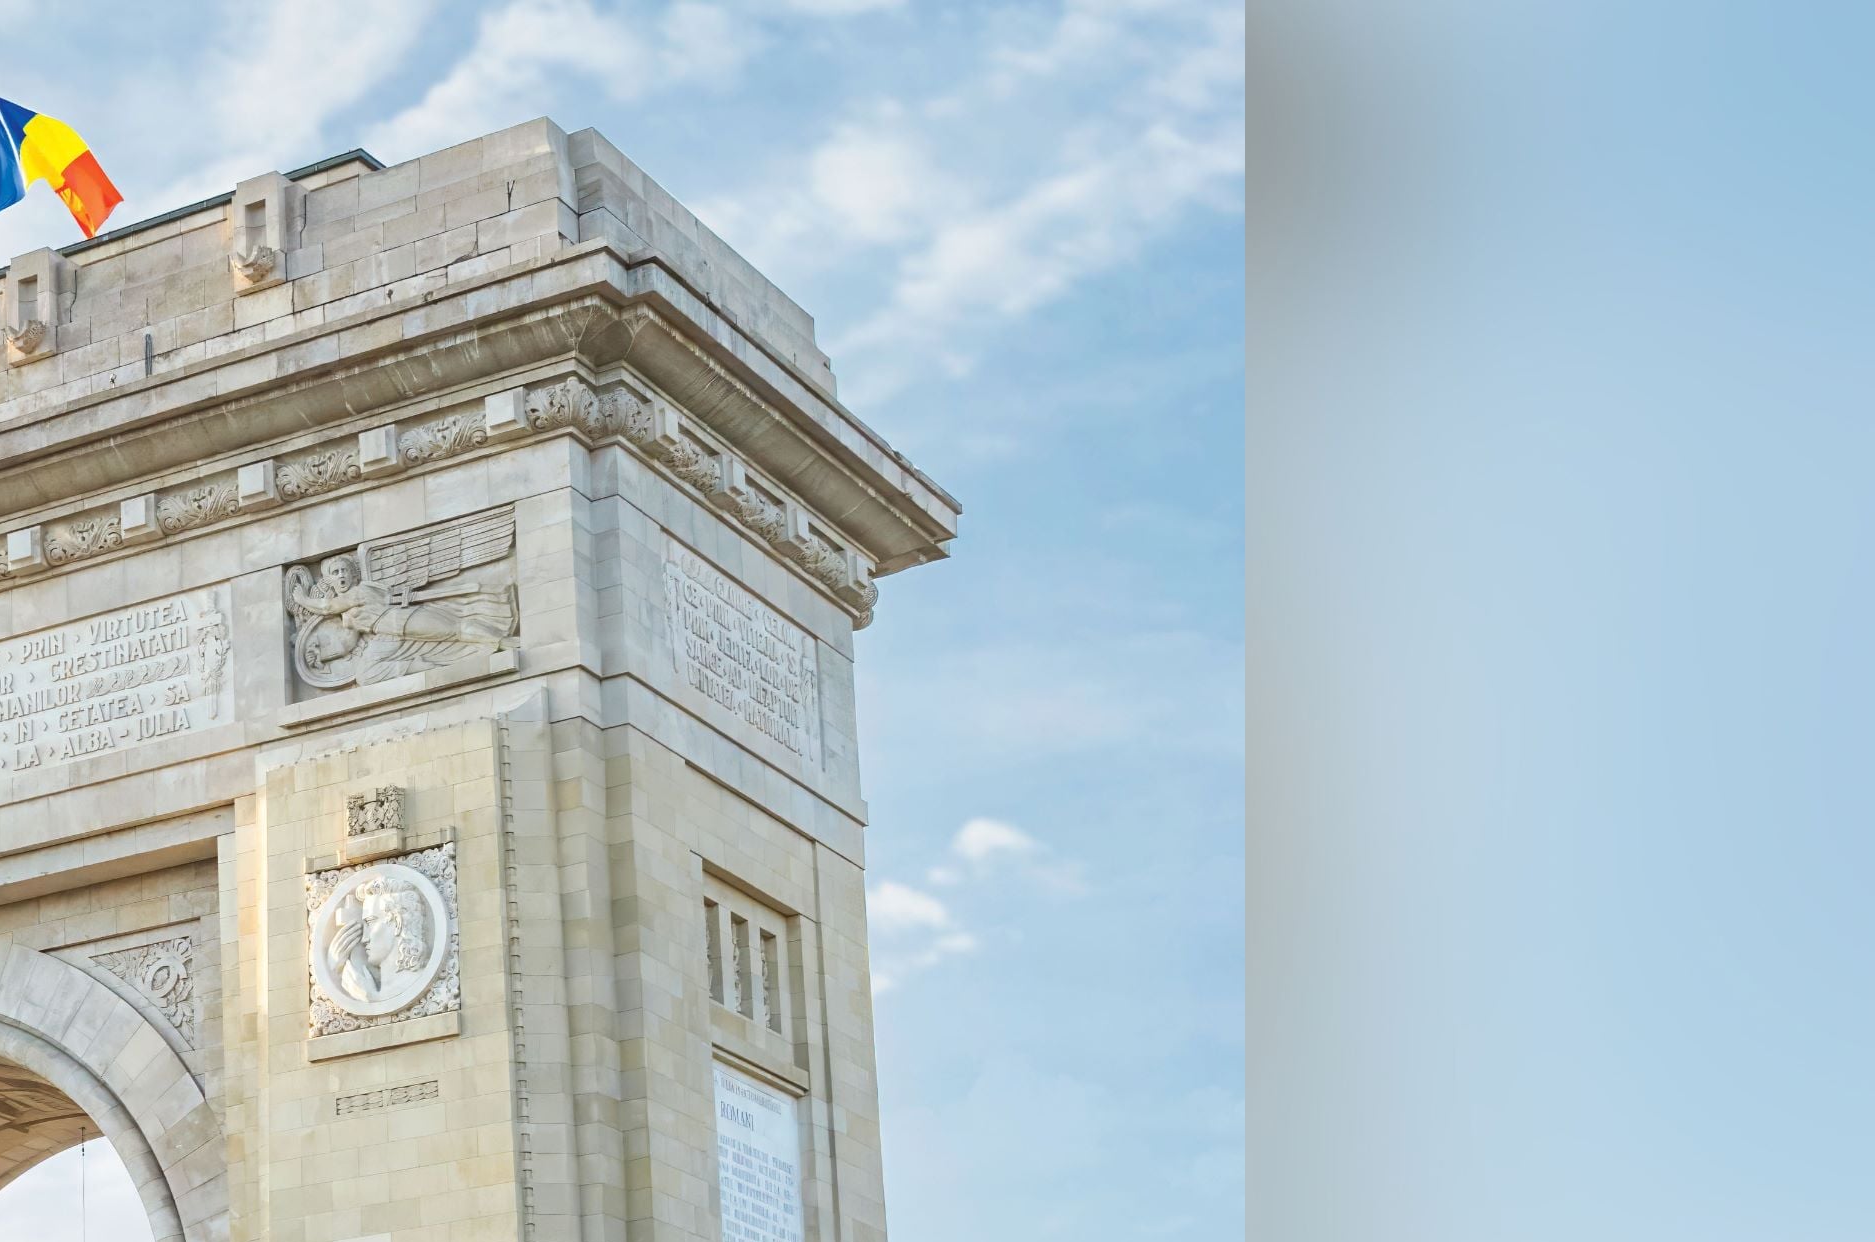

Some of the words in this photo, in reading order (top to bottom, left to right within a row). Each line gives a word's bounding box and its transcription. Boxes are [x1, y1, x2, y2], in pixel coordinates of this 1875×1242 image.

[20, 632, 65, 664] PRIN
[89, 600, 188, 645] VIRTUTEA
[51, 625, 188, 682] CRESTINATATII
[14, 719, 34, 745] IN
[58, 693, 144, 733] CETATEA
[164, 680, 190, 707] SA
[13, 745, 41, 771] LA
